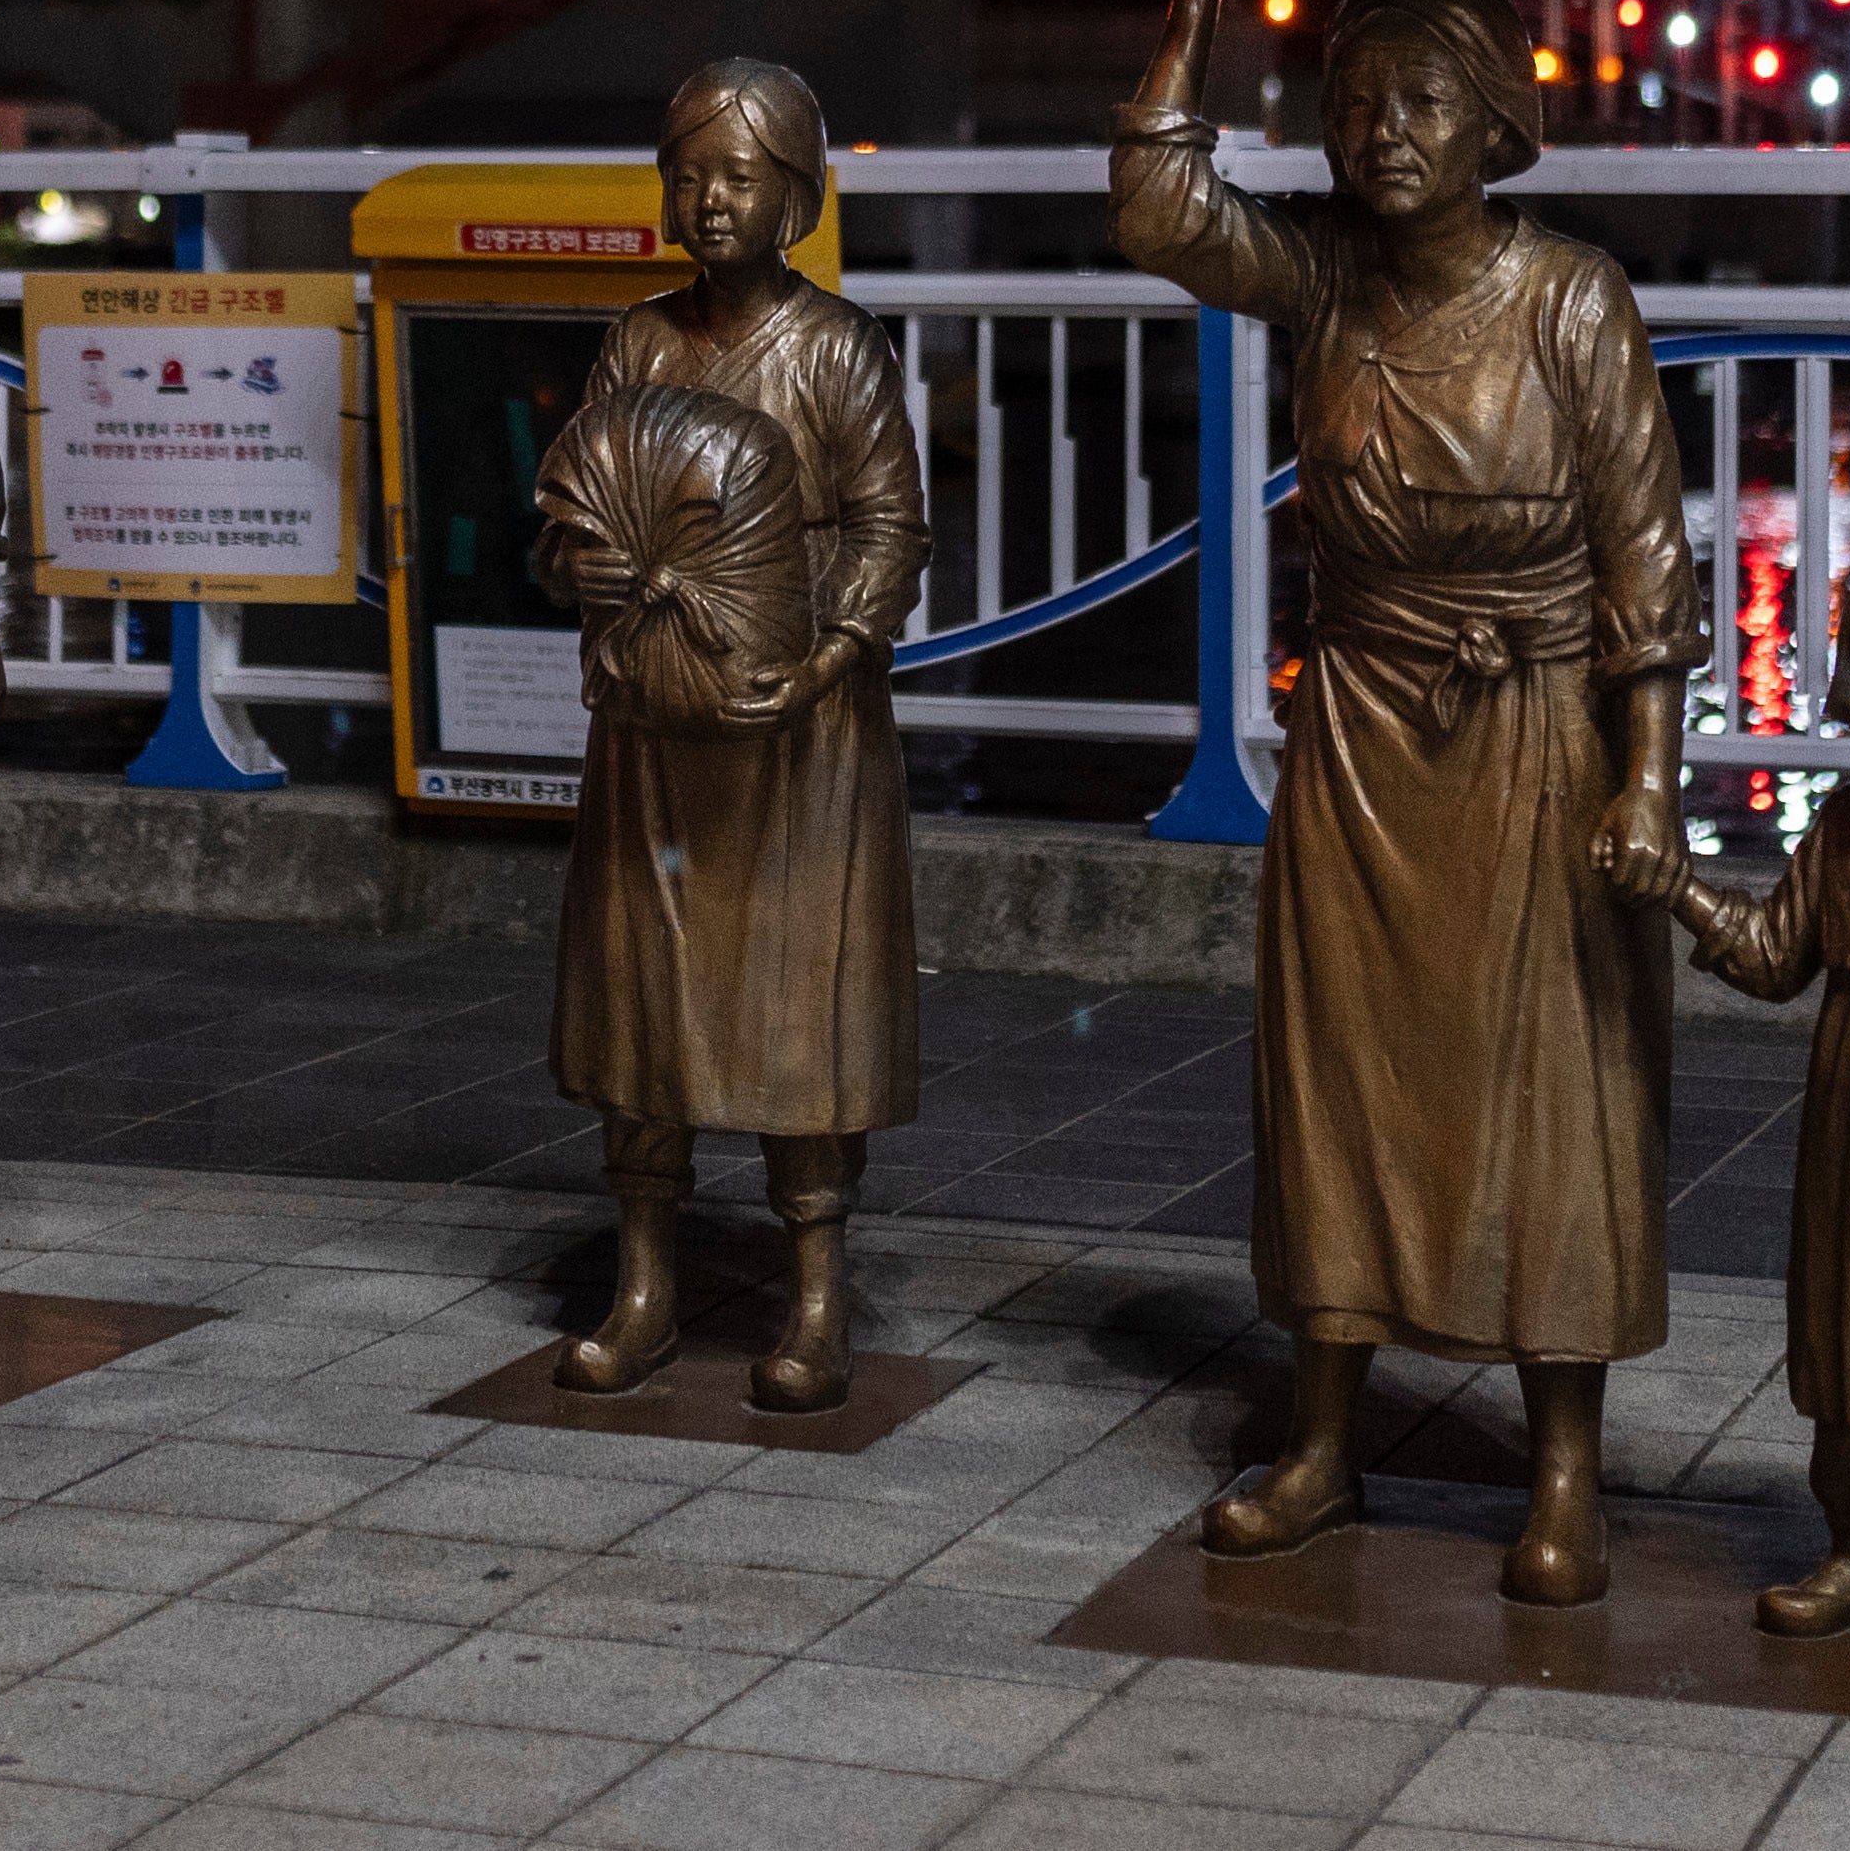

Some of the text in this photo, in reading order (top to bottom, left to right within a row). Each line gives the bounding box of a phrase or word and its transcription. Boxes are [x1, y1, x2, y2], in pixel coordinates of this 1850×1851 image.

[473, 228, 644, 253] 인명구조장비 보관함
[82, 288, 286, 314] 연안해상 긴급 구조벨
[230, 423, 271, 439] 누르면
[79, 506, 111, 522] 구조벨
[207, 508, 233, 525] 인한
[157, 530, 168, 543] 수
[173, 530, 211, 545] 있으니
[451, 777, 524, 799] 부산광역시
